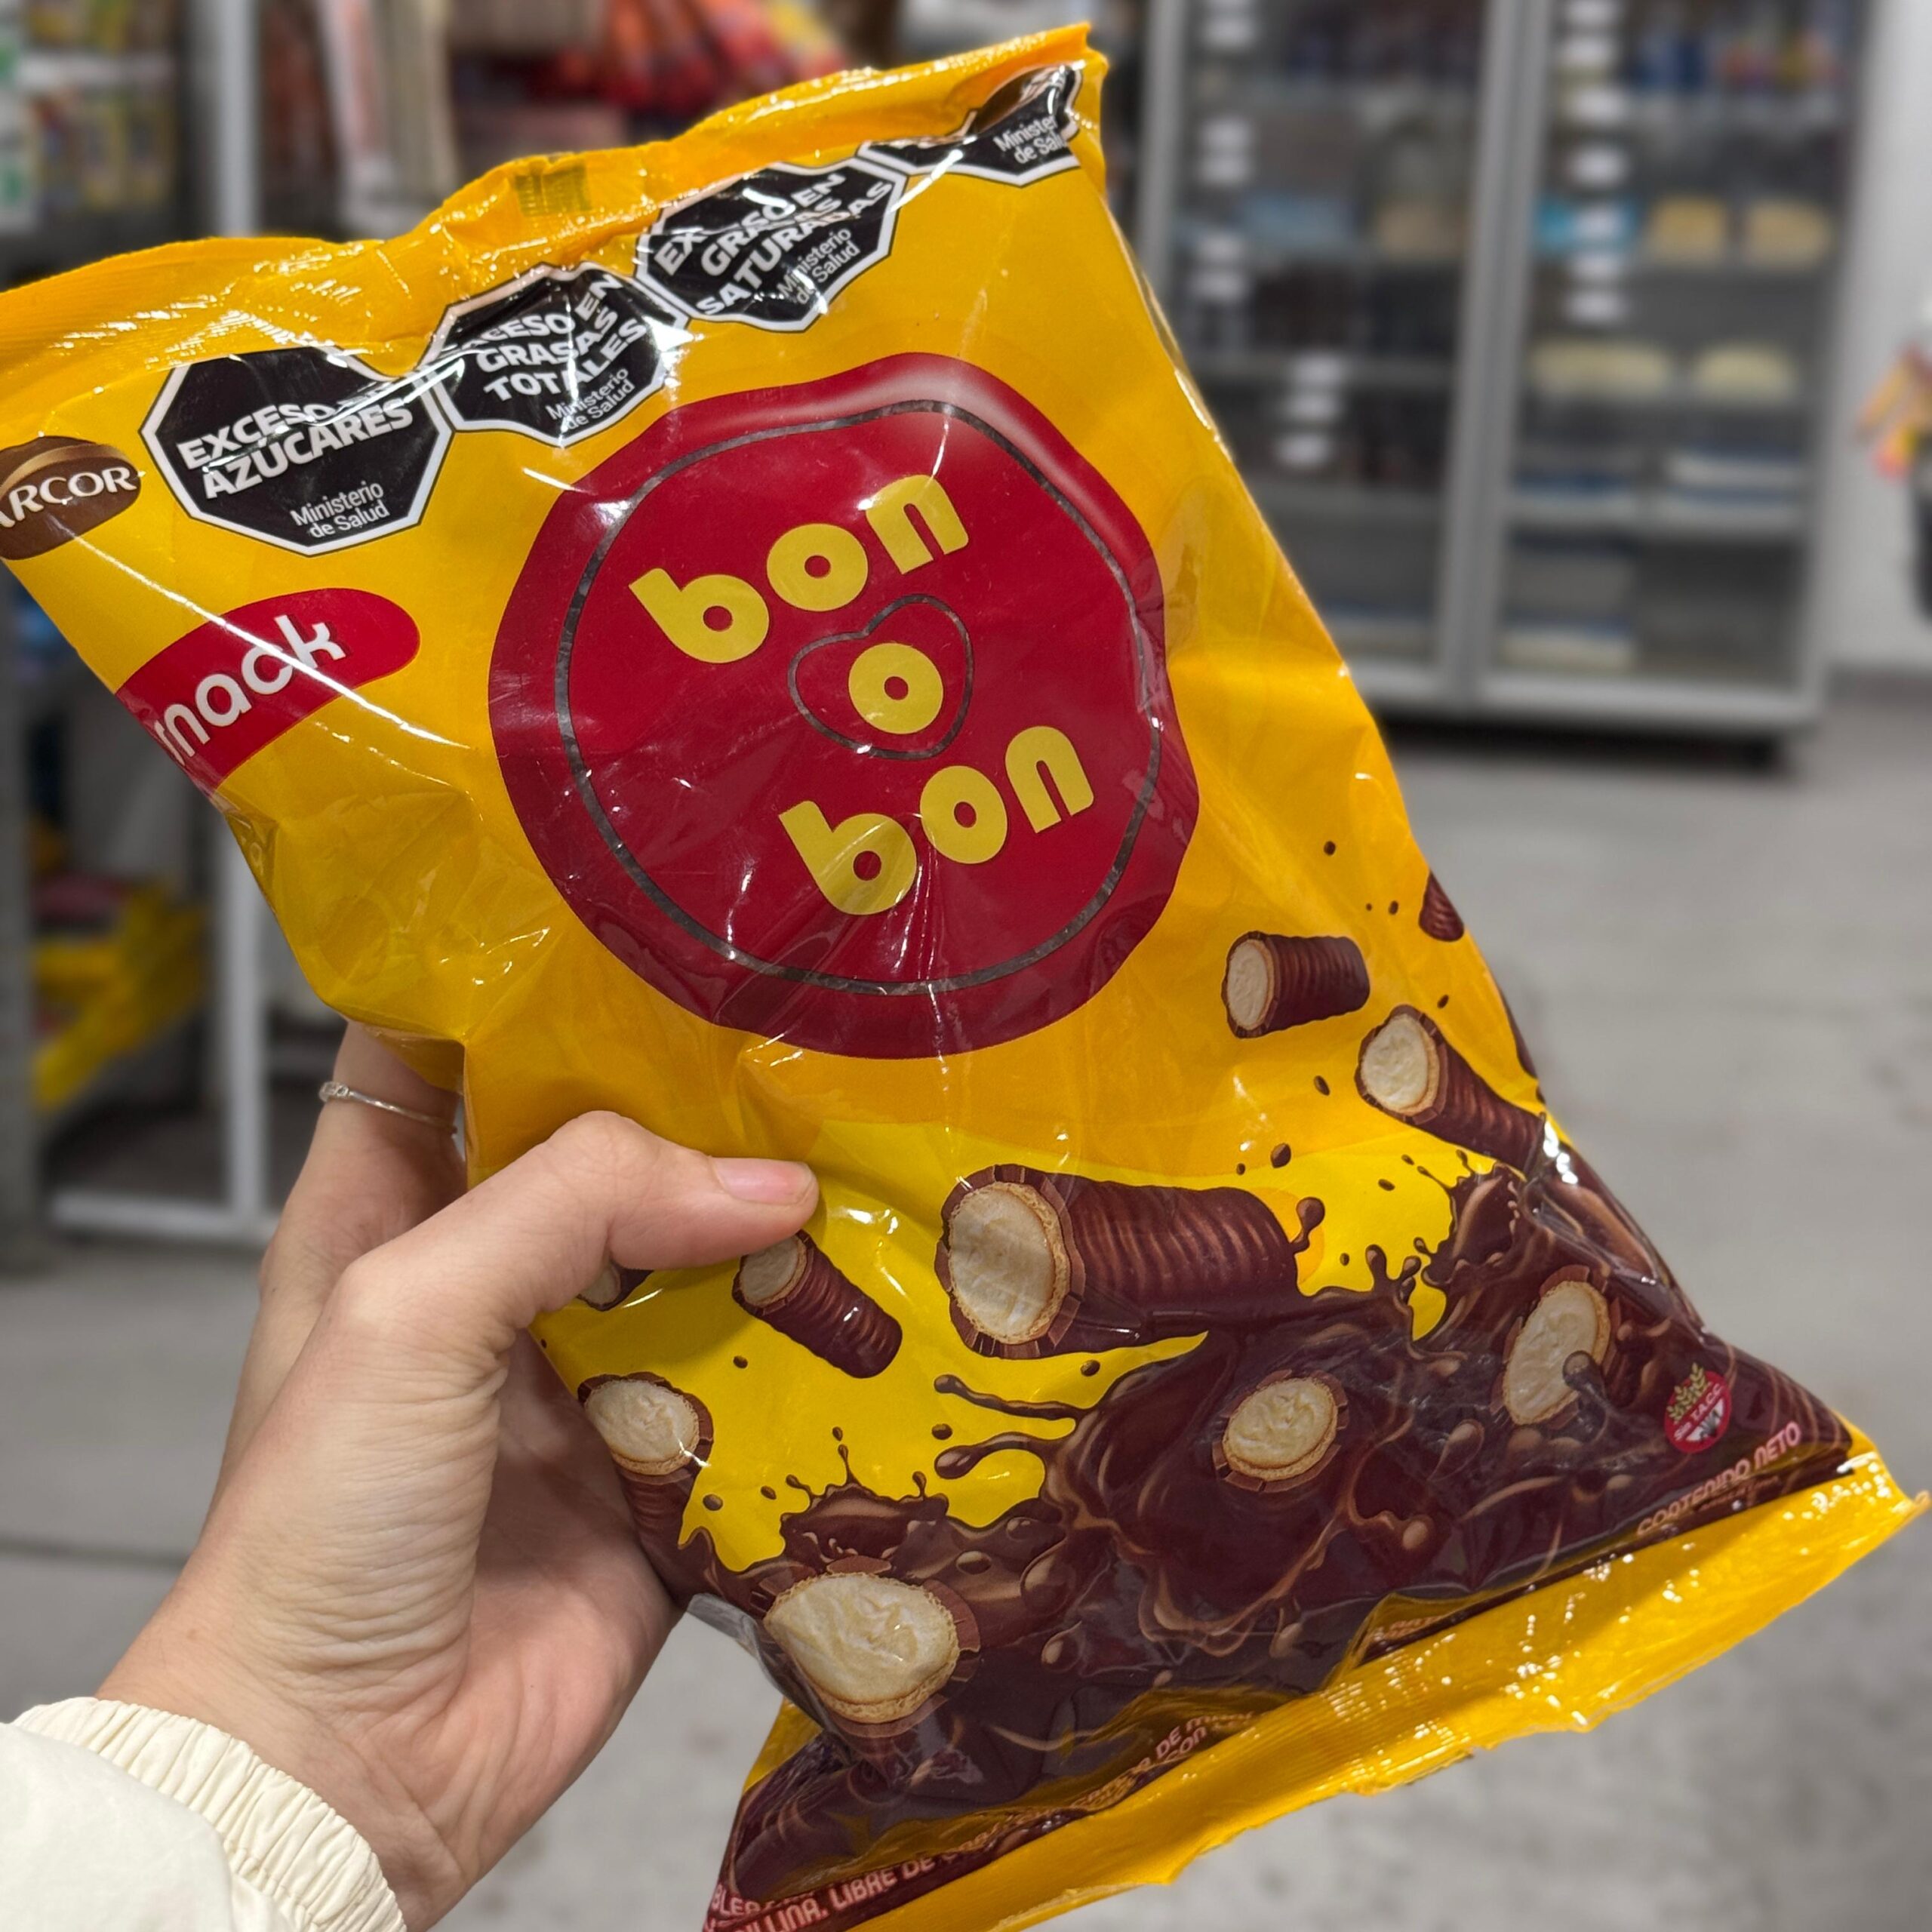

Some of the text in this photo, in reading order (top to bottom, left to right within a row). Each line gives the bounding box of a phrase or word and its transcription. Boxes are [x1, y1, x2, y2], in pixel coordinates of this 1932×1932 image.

[1014, 146, 1038, 164] de
[790, 173, 847, 208] EN
[776, 228, 851, 303] Ministerio
[811, 239, 861, 283] Salud
[574, 273, 623, 321] EN
[475, 306, 619, 373] GRASAS
[483, 318, 648, 401] TOTALES
[545, 367, 629, 420] Ministerio
[586, 380, 635, 420] Salud
[176, 403, 335, 470] EXCESO
[290, 479, 385, 527] Ministerio
[308, 499, 390, 539] de Salud
[628, 474, 970, 663] bon
[848, 642, 944, 735] o
[777, 725, 1094, 916] bon
[1753, 1421, 1802, 1471] NETO
[829, 1869, 898, 1911] LIBRE
